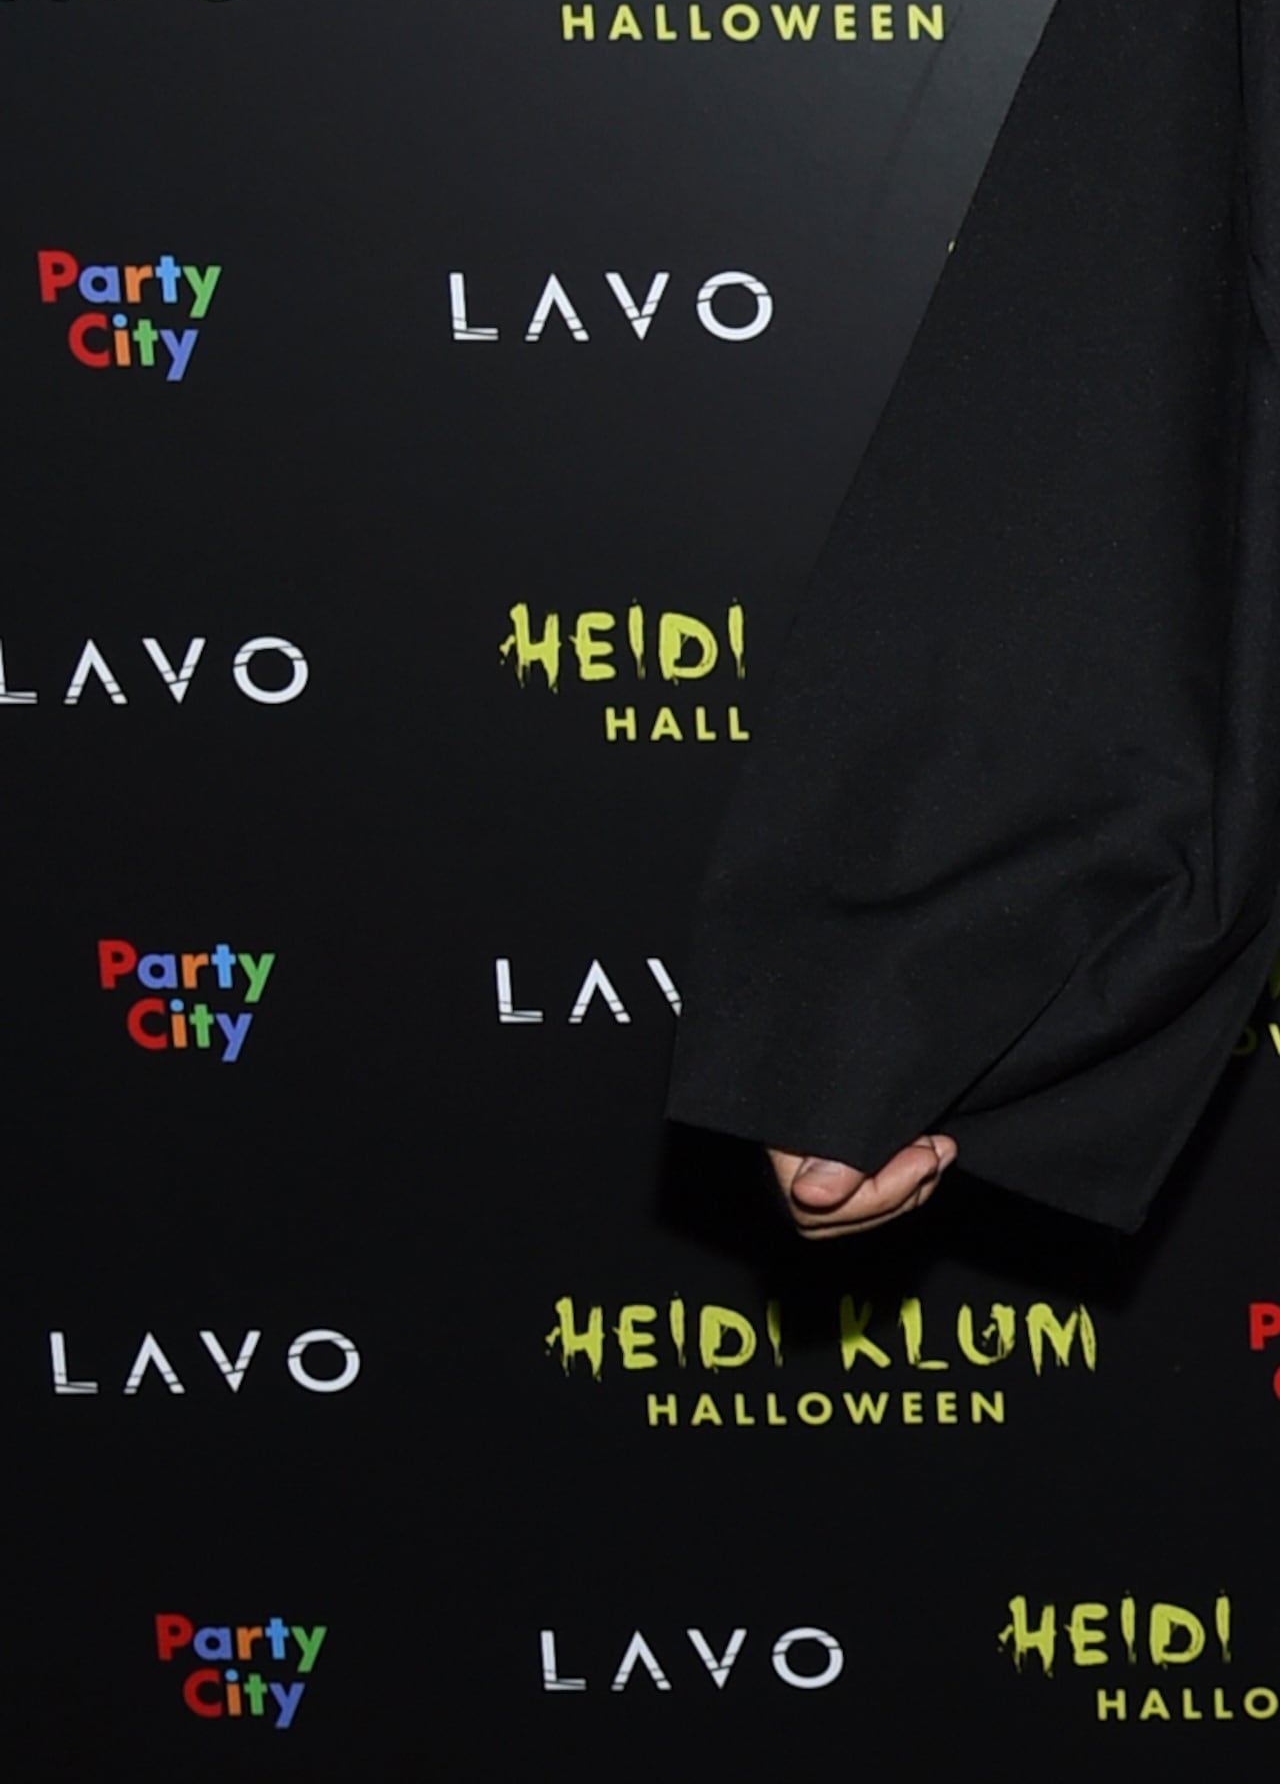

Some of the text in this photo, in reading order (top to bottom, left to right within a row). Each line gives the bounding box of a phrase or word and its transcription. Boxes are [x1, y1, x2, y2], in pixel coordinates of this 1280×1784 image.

[562, 4, 943, 41] HALLOWEEN
[38, 250, 221, 318] Party
[449, 271, 773, 341] LAVO
[68, 311, 198, 381] City
[0, 637, 308, 704] LAVO
[500, 600, 745, 693] HEIDI
[98, 939, 275, 1003] Party
[127, 997, 252, 1062] City
[50, 1329, 360, 1394] LAVO
[545, 1297, 1096, 1381] HEIDI KLUM
[648, 1391, 1004, 1426] HALLOWEEN
[155, 1613, 326, 1672] Party
[541, 1627, 843, 1691] LAVO
[998, 1595, 1230, 1677] HEIDI
[183, 1668, 305, 1729] City
